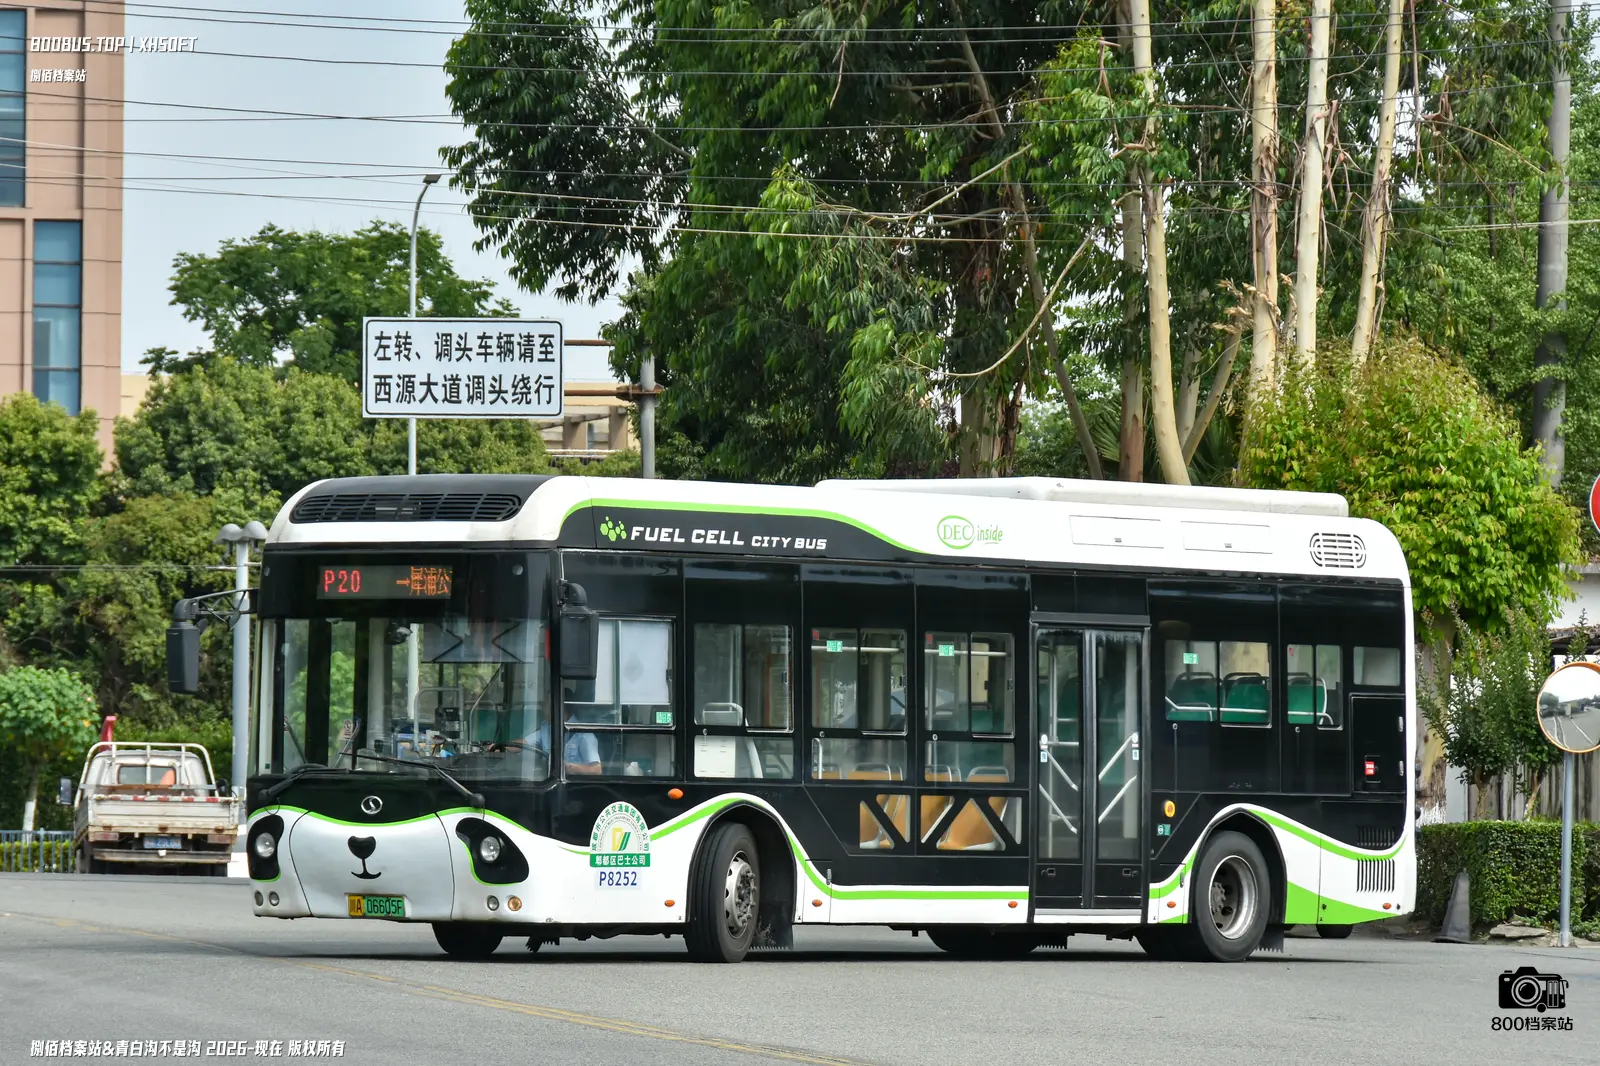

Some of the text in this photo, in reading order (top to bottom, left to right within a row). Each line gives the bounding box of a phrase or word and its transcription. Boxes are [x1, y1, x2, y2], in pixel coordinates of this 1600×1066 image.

[373, 331, 556, 363] 左转、调头车辆请至
[373, 373, 555, 405] 西源大道调头绕行
[630, 526, 828, 550] FUEL CELL CITY BUS
[943, 524, 1004, 542] DEC inside
[323, 569, 361, 593] P20
[599, 871, 638, 887] P8252
